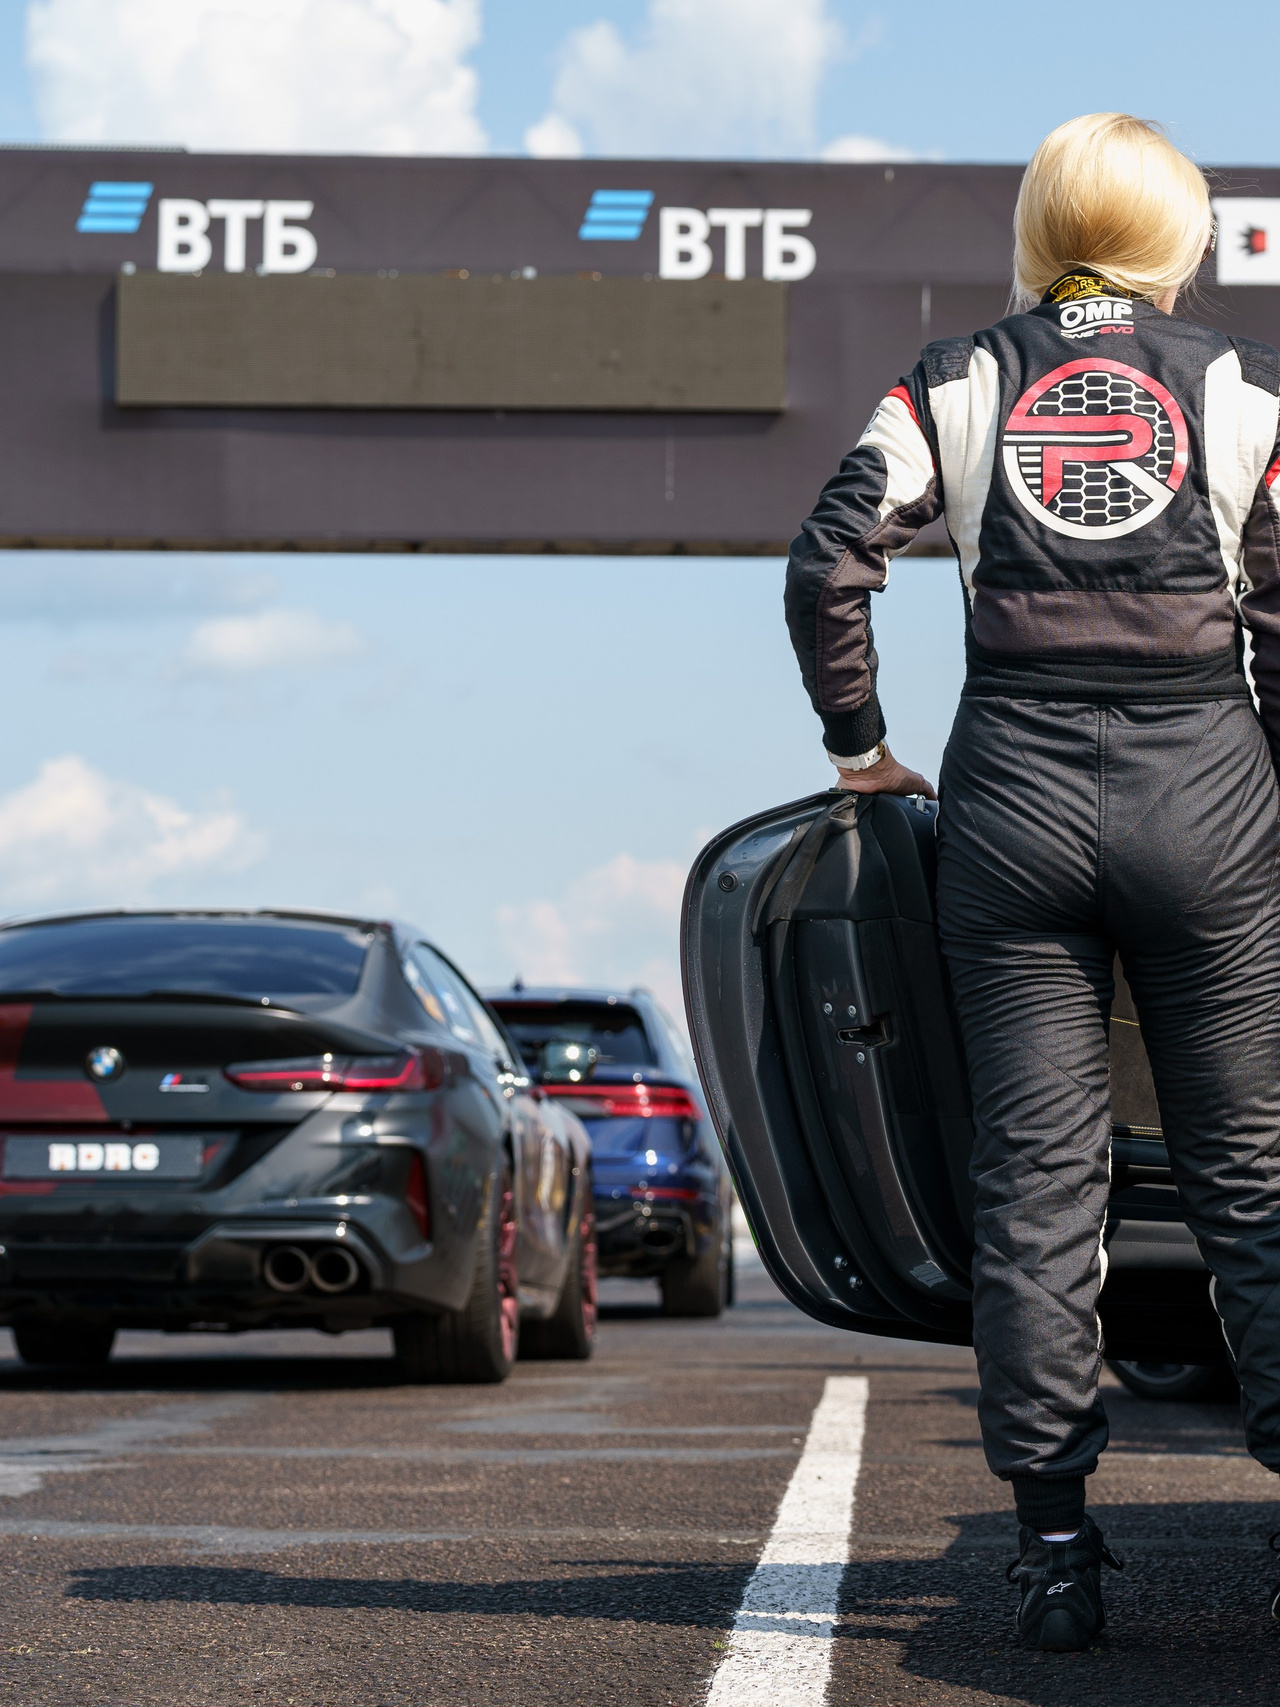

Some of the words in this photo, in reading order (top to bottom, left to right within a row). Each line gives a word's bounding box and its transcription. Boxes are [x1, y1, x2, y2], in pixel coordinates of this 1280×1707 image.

[157, 198, 318, 274] ВТБ
[659, 206, 817, 281] ВТБ
[1060, 301, 1133, 328] OMP
[48, 1143, 160, 1171] RDRC
